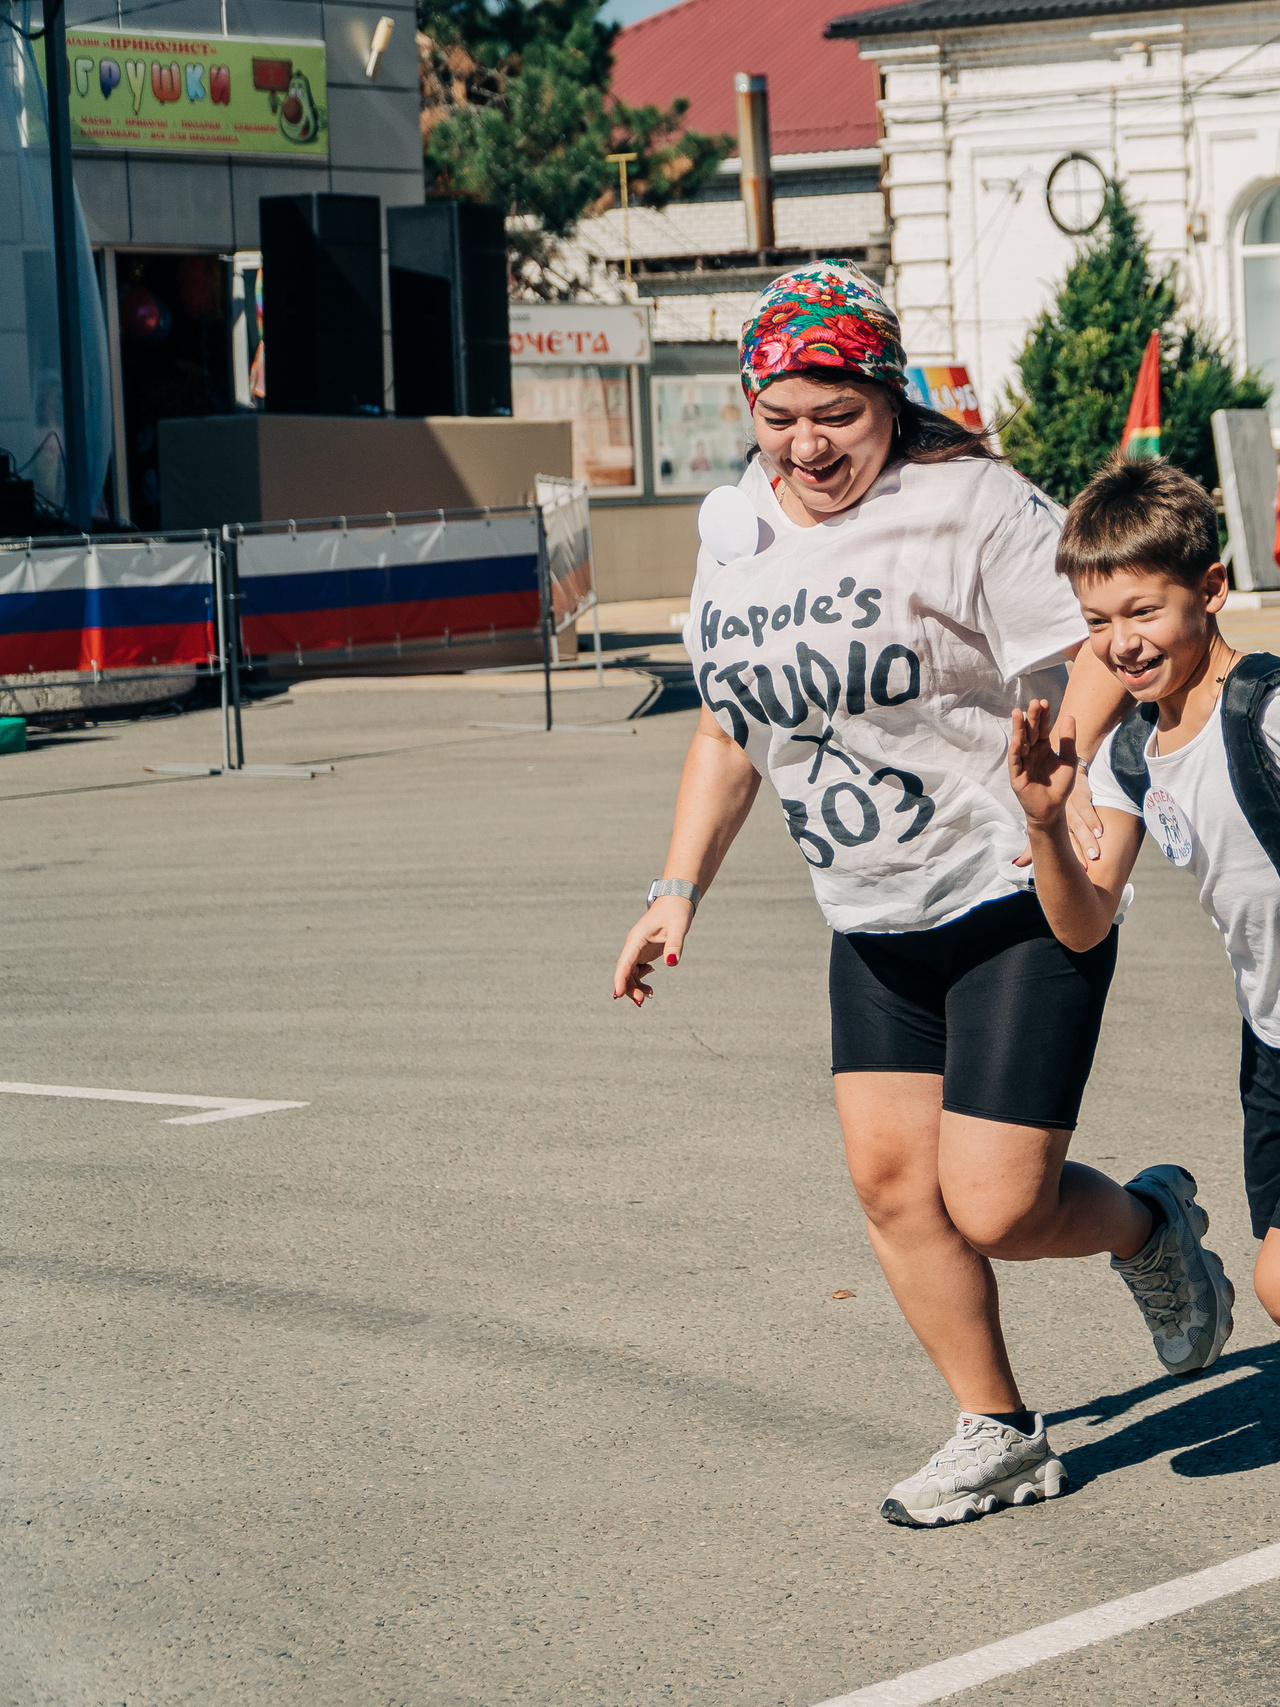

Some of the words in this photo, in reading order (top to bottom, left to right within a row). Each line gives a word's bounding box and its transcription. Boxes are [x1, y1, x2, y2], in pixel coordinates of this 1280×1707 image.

[66, 36, 100, 47] АГАЗИН
[67, 55, 231, 116] ГРУШКИ
[509, 330, 609, 354] ОЧЕТА
[699, 640, 920, 750] STUDIO
